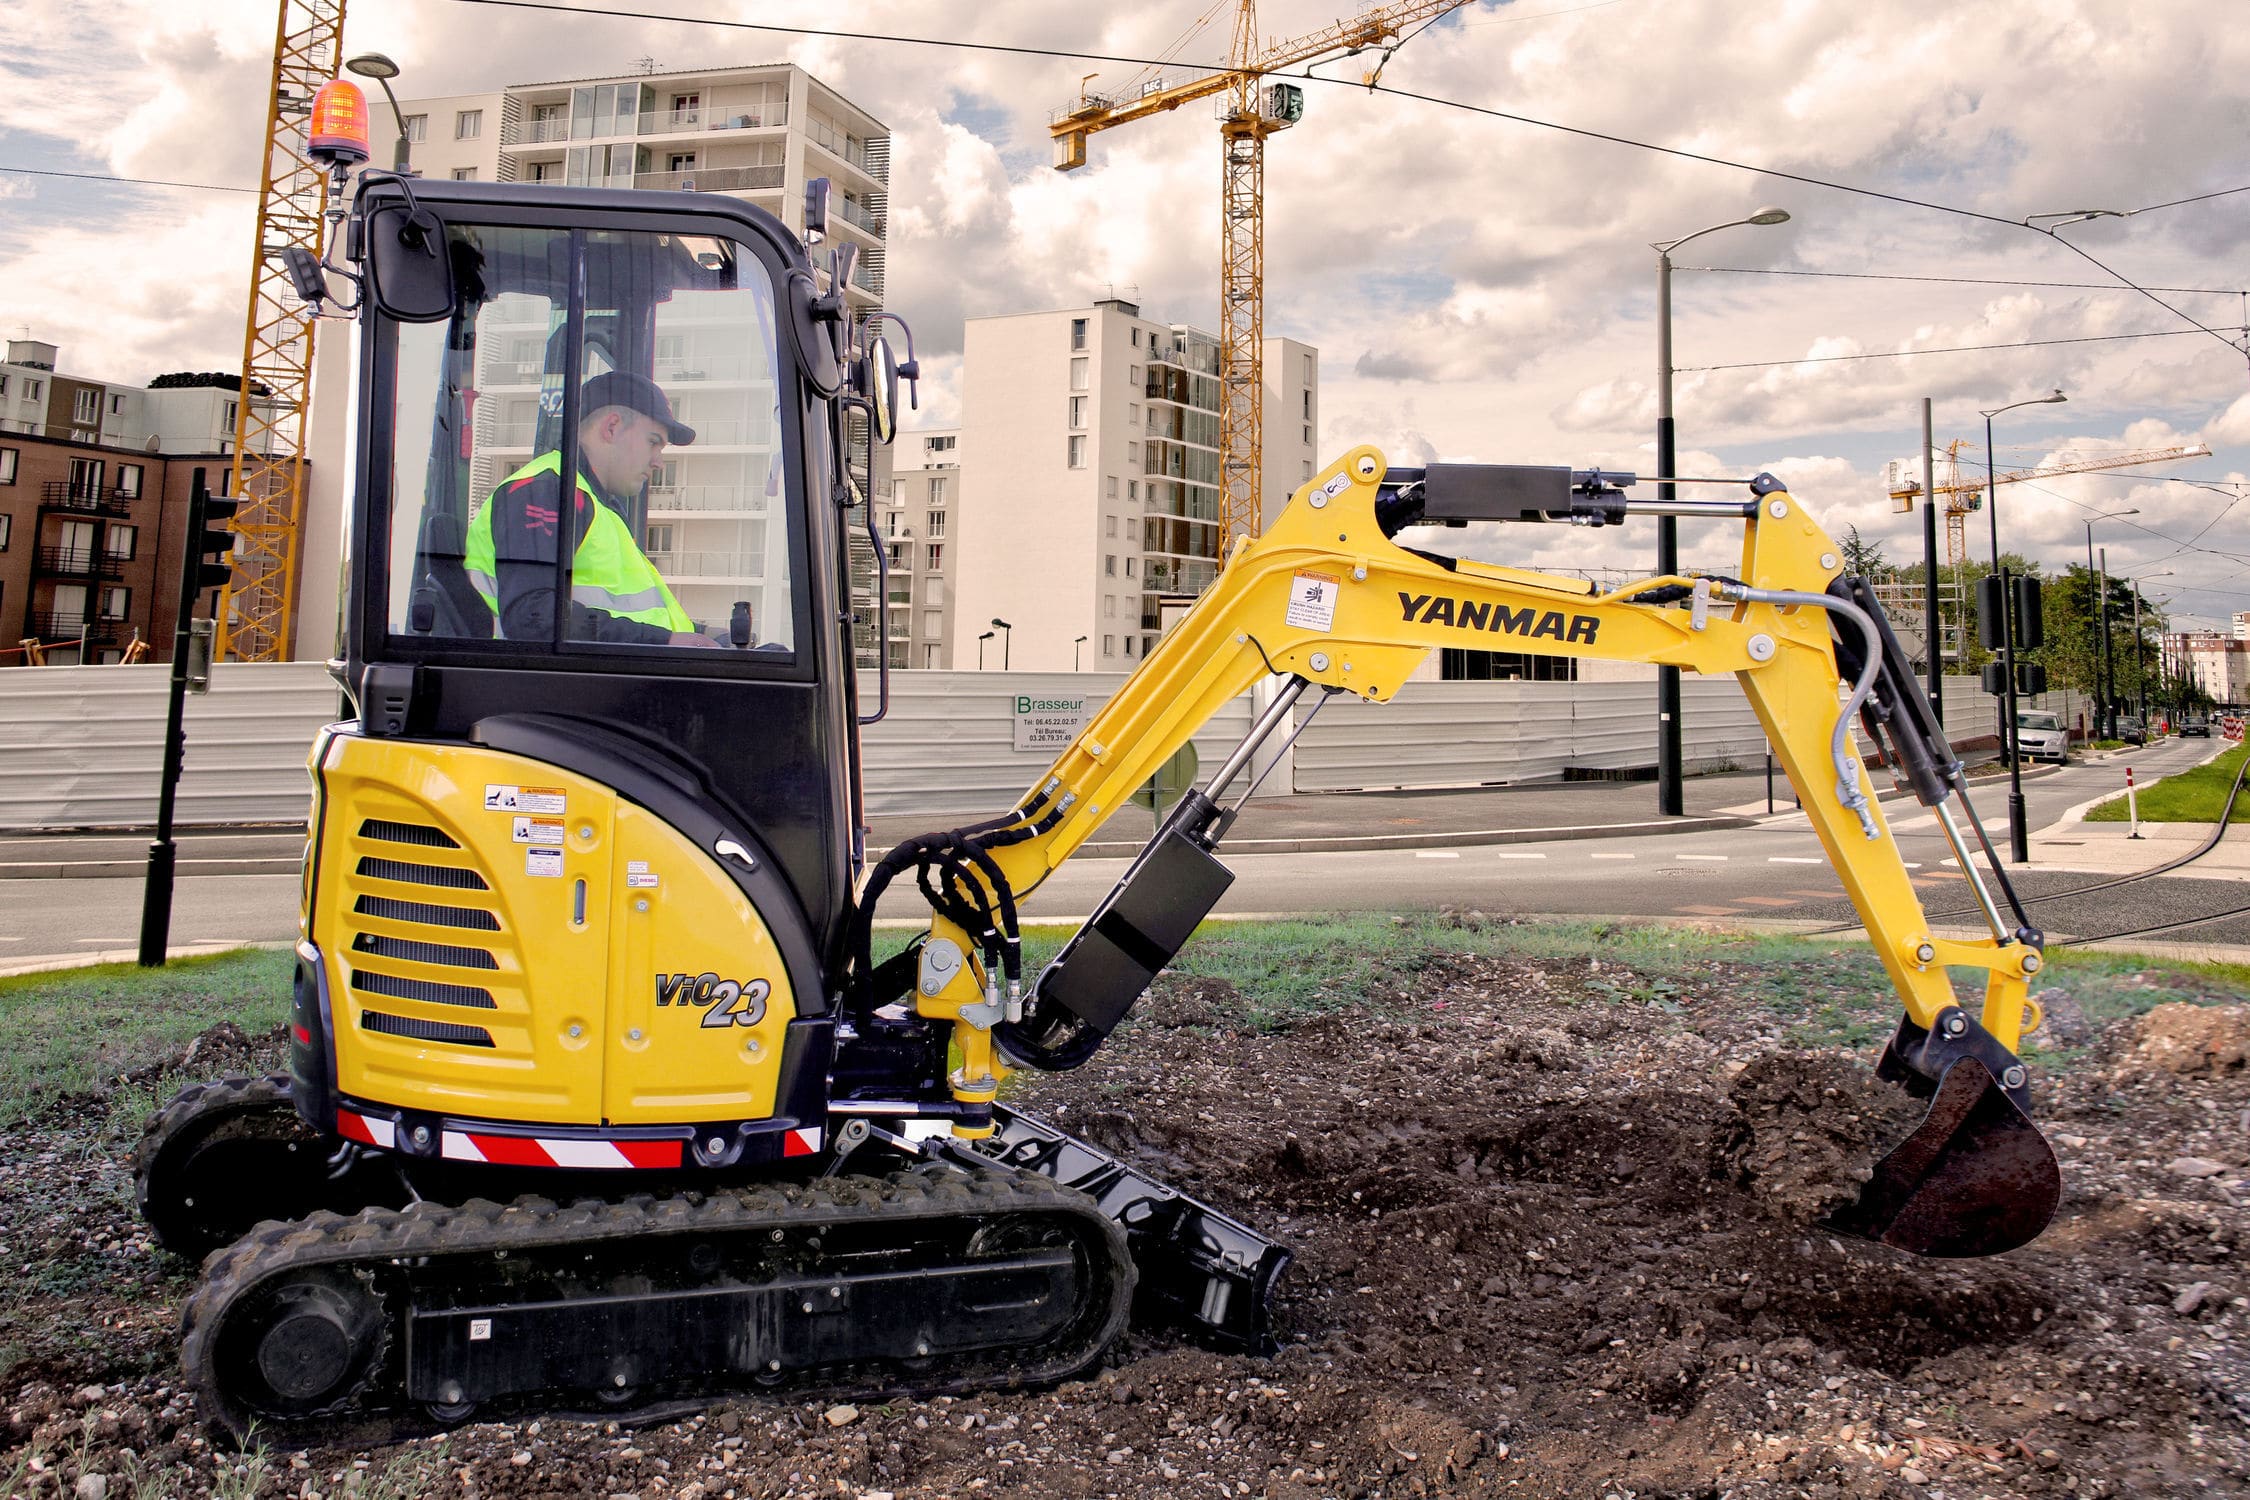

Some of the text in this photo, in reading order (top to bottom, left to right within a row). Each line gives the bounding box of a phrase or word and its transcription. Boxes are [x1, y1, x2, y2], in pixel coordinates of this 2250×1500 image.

[1143, 79, 1161, 94] BEC
[1397, 591, 1601, 645] YANMAR
[1018, 696, 1084, 714] Brasseur
